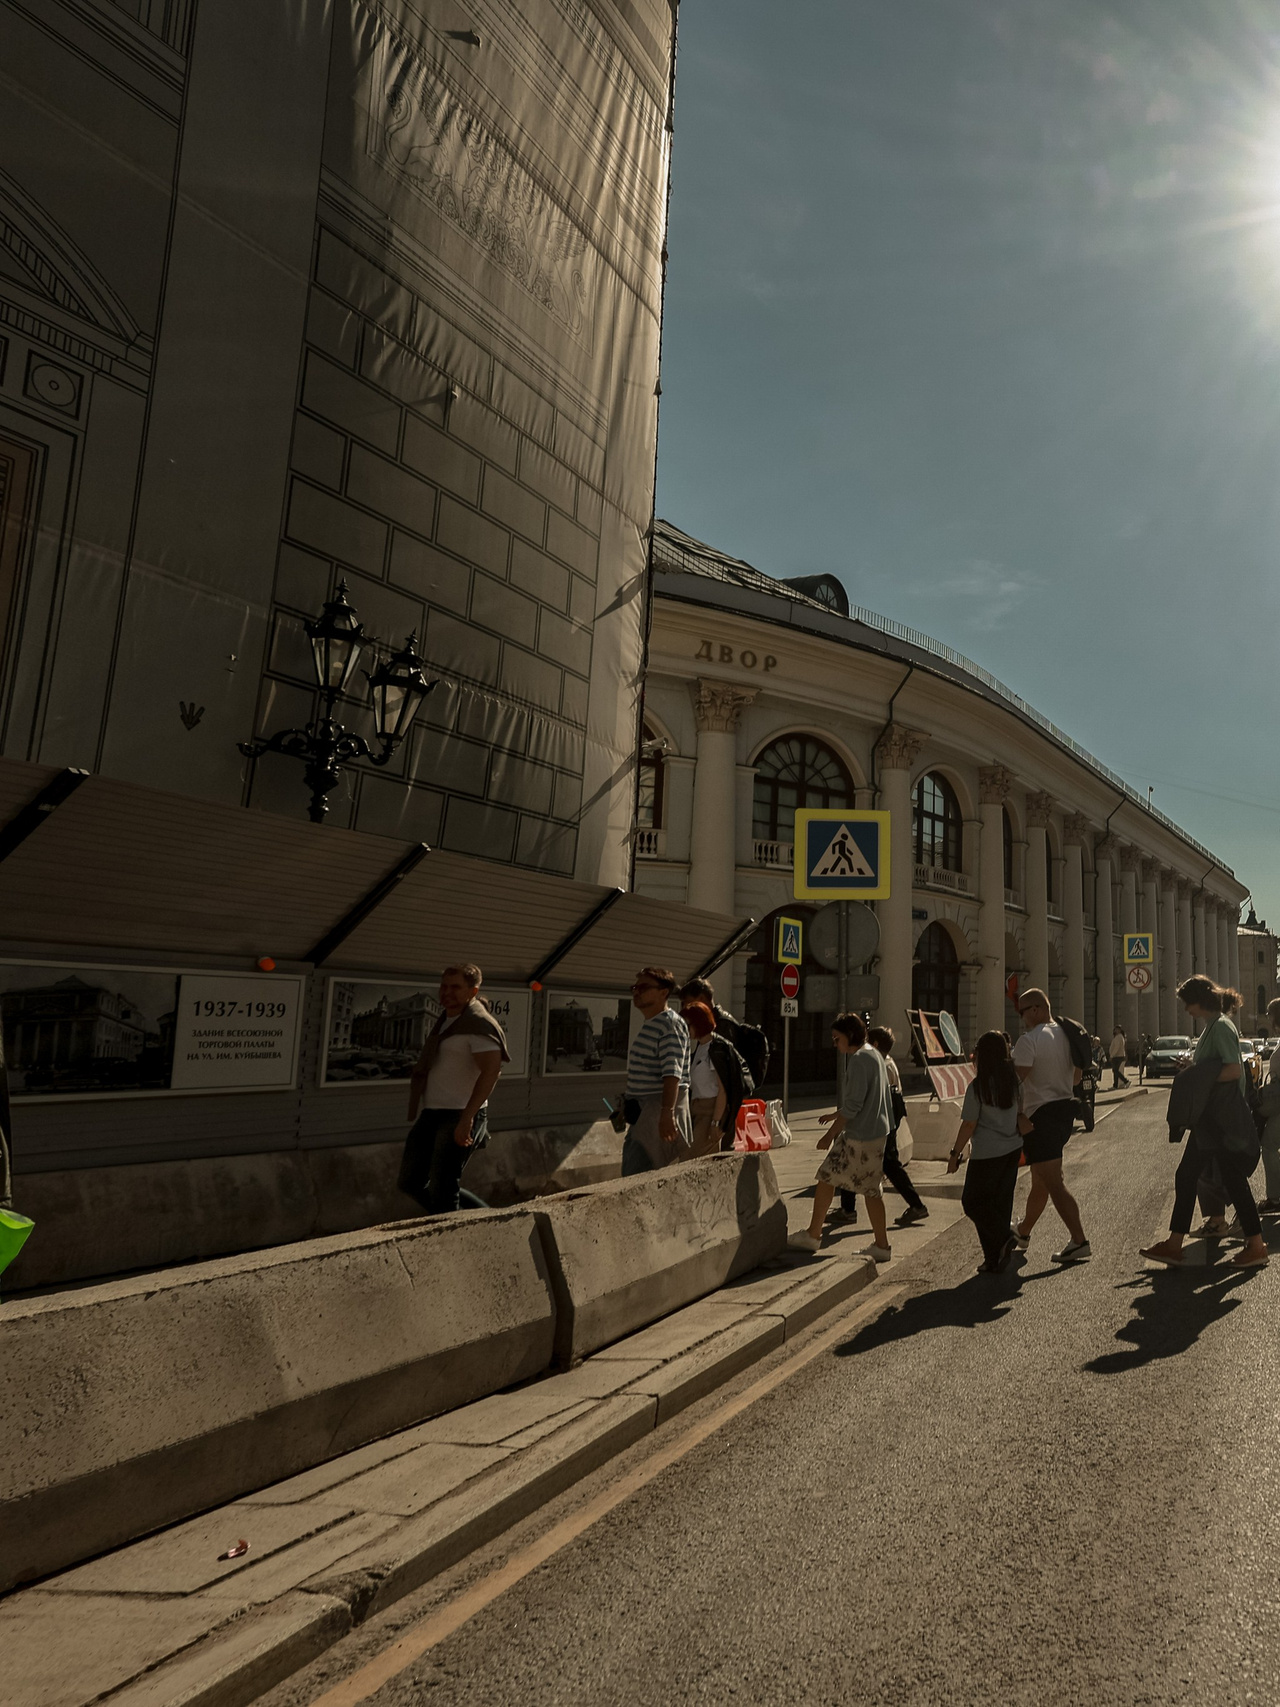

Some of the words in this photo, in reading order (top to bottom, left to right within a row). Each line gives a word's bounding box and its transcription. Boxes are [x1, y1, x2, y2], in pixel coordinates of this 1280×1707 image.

[695, 640, 777, 672] ДВОР
[193, 1000, 286, 1018] 1937-1939
[488, 1000, 510, 1016] 964
[191, 1029, 225, 1037] ЗДАНИЕ
[226, 1029, 283, 1037] ВСЕСОЮЗНОЙ
[198, 1040, 242, 1049] ТОРГОВОЙ
[243, 1040, 275, 1048] ПАЛАТЫ
[187, 1052, 199, 1061] НА
[202, 1052, 214, 1060] УЛ.
[216, 1052, 232, 1060] ИМ.
[234, 1051, 282, 1060] КУЙБЫШЕВА
